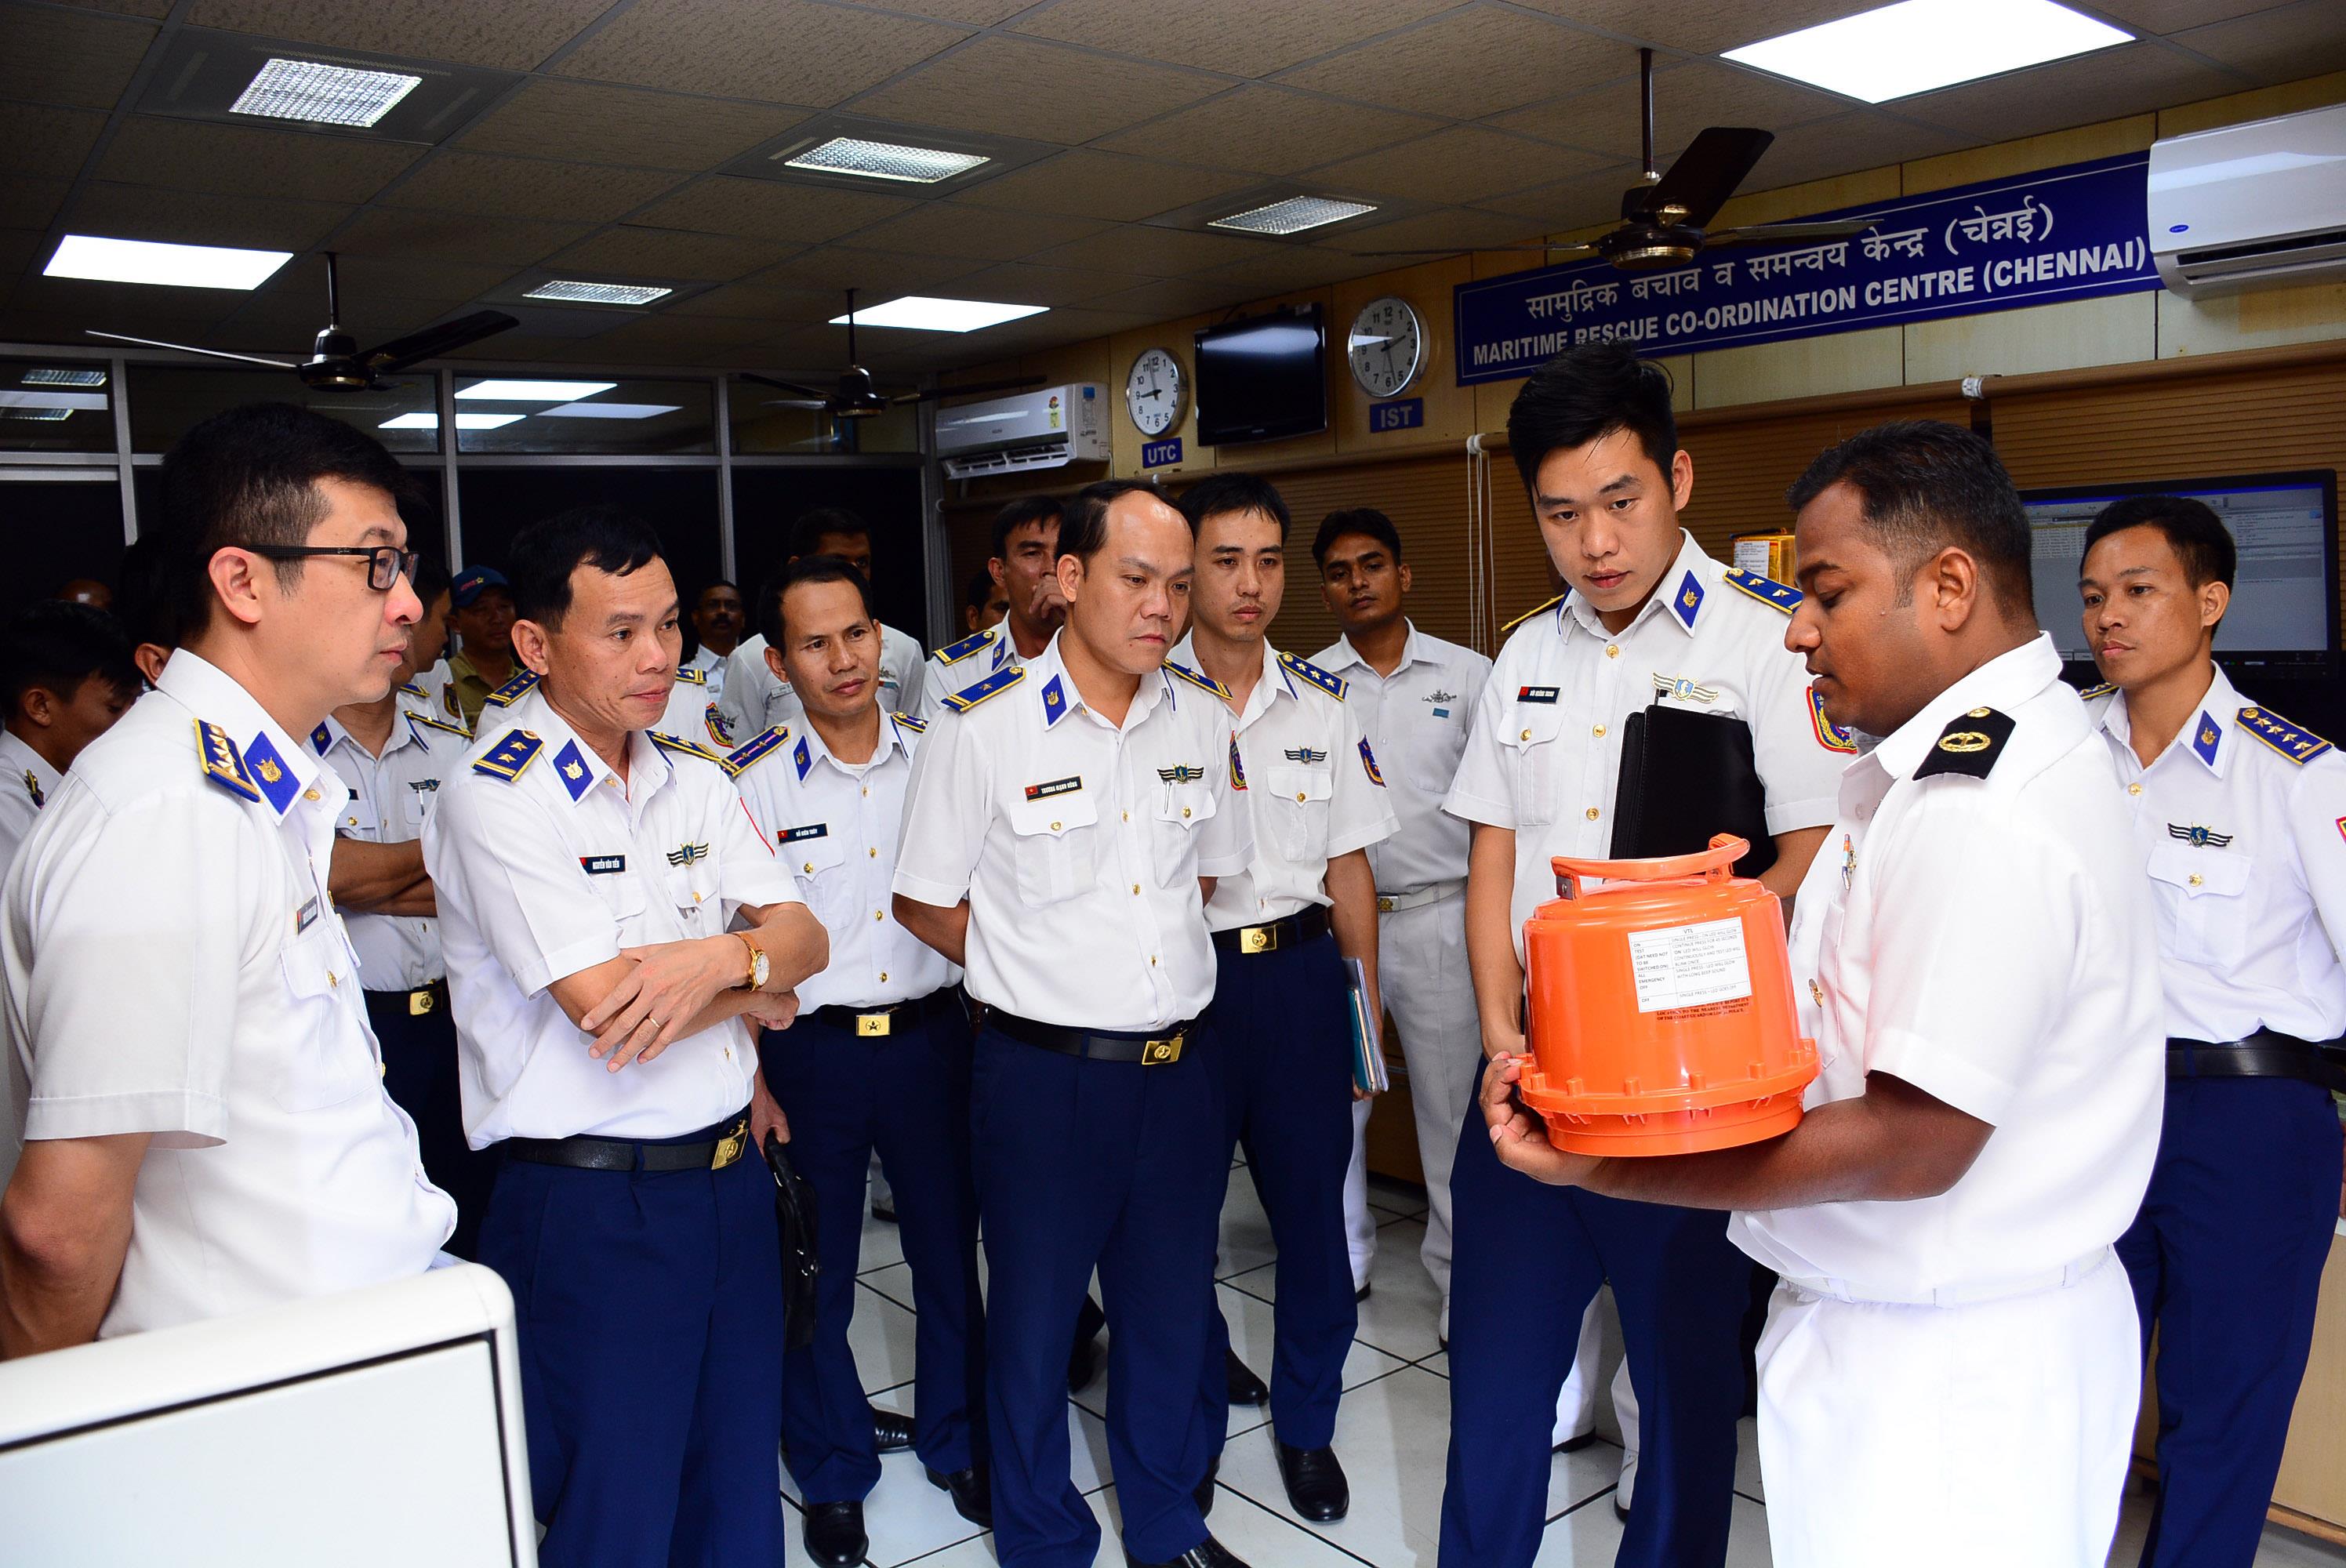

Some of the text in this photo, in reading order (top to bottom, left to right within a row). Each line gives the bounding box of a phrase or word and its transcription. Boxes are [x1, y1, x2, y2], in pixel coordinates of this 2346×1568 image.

[1526, 194, 2054, 322] सामुद्रिक बचाव व समन्वय केन्द्र (चेन्नई)
[1473, 236, 2146, 365] MARITIME RESCUE CO-ORDINATION CENTRE (CHENNAI)
[1384, 307, 1393, 317] 12
[1373, 314, 1379, 324] 11
[1407, 321, 1413, 332] 2
[1411, 339, 1416, 349] 3
[1361, 346, 1367, 355] 9
[1365, 362, 1370, 372] 8
[1407, 357, 1412, 366] 4
[1374, 373, 1379, 384] 7
[1397, 370, 1404, 381] 5
[1385, 376, 1391, 387] 6
[1381, 405, 1412, 428] IST
[1148, 443, 1176, 464] UTC
